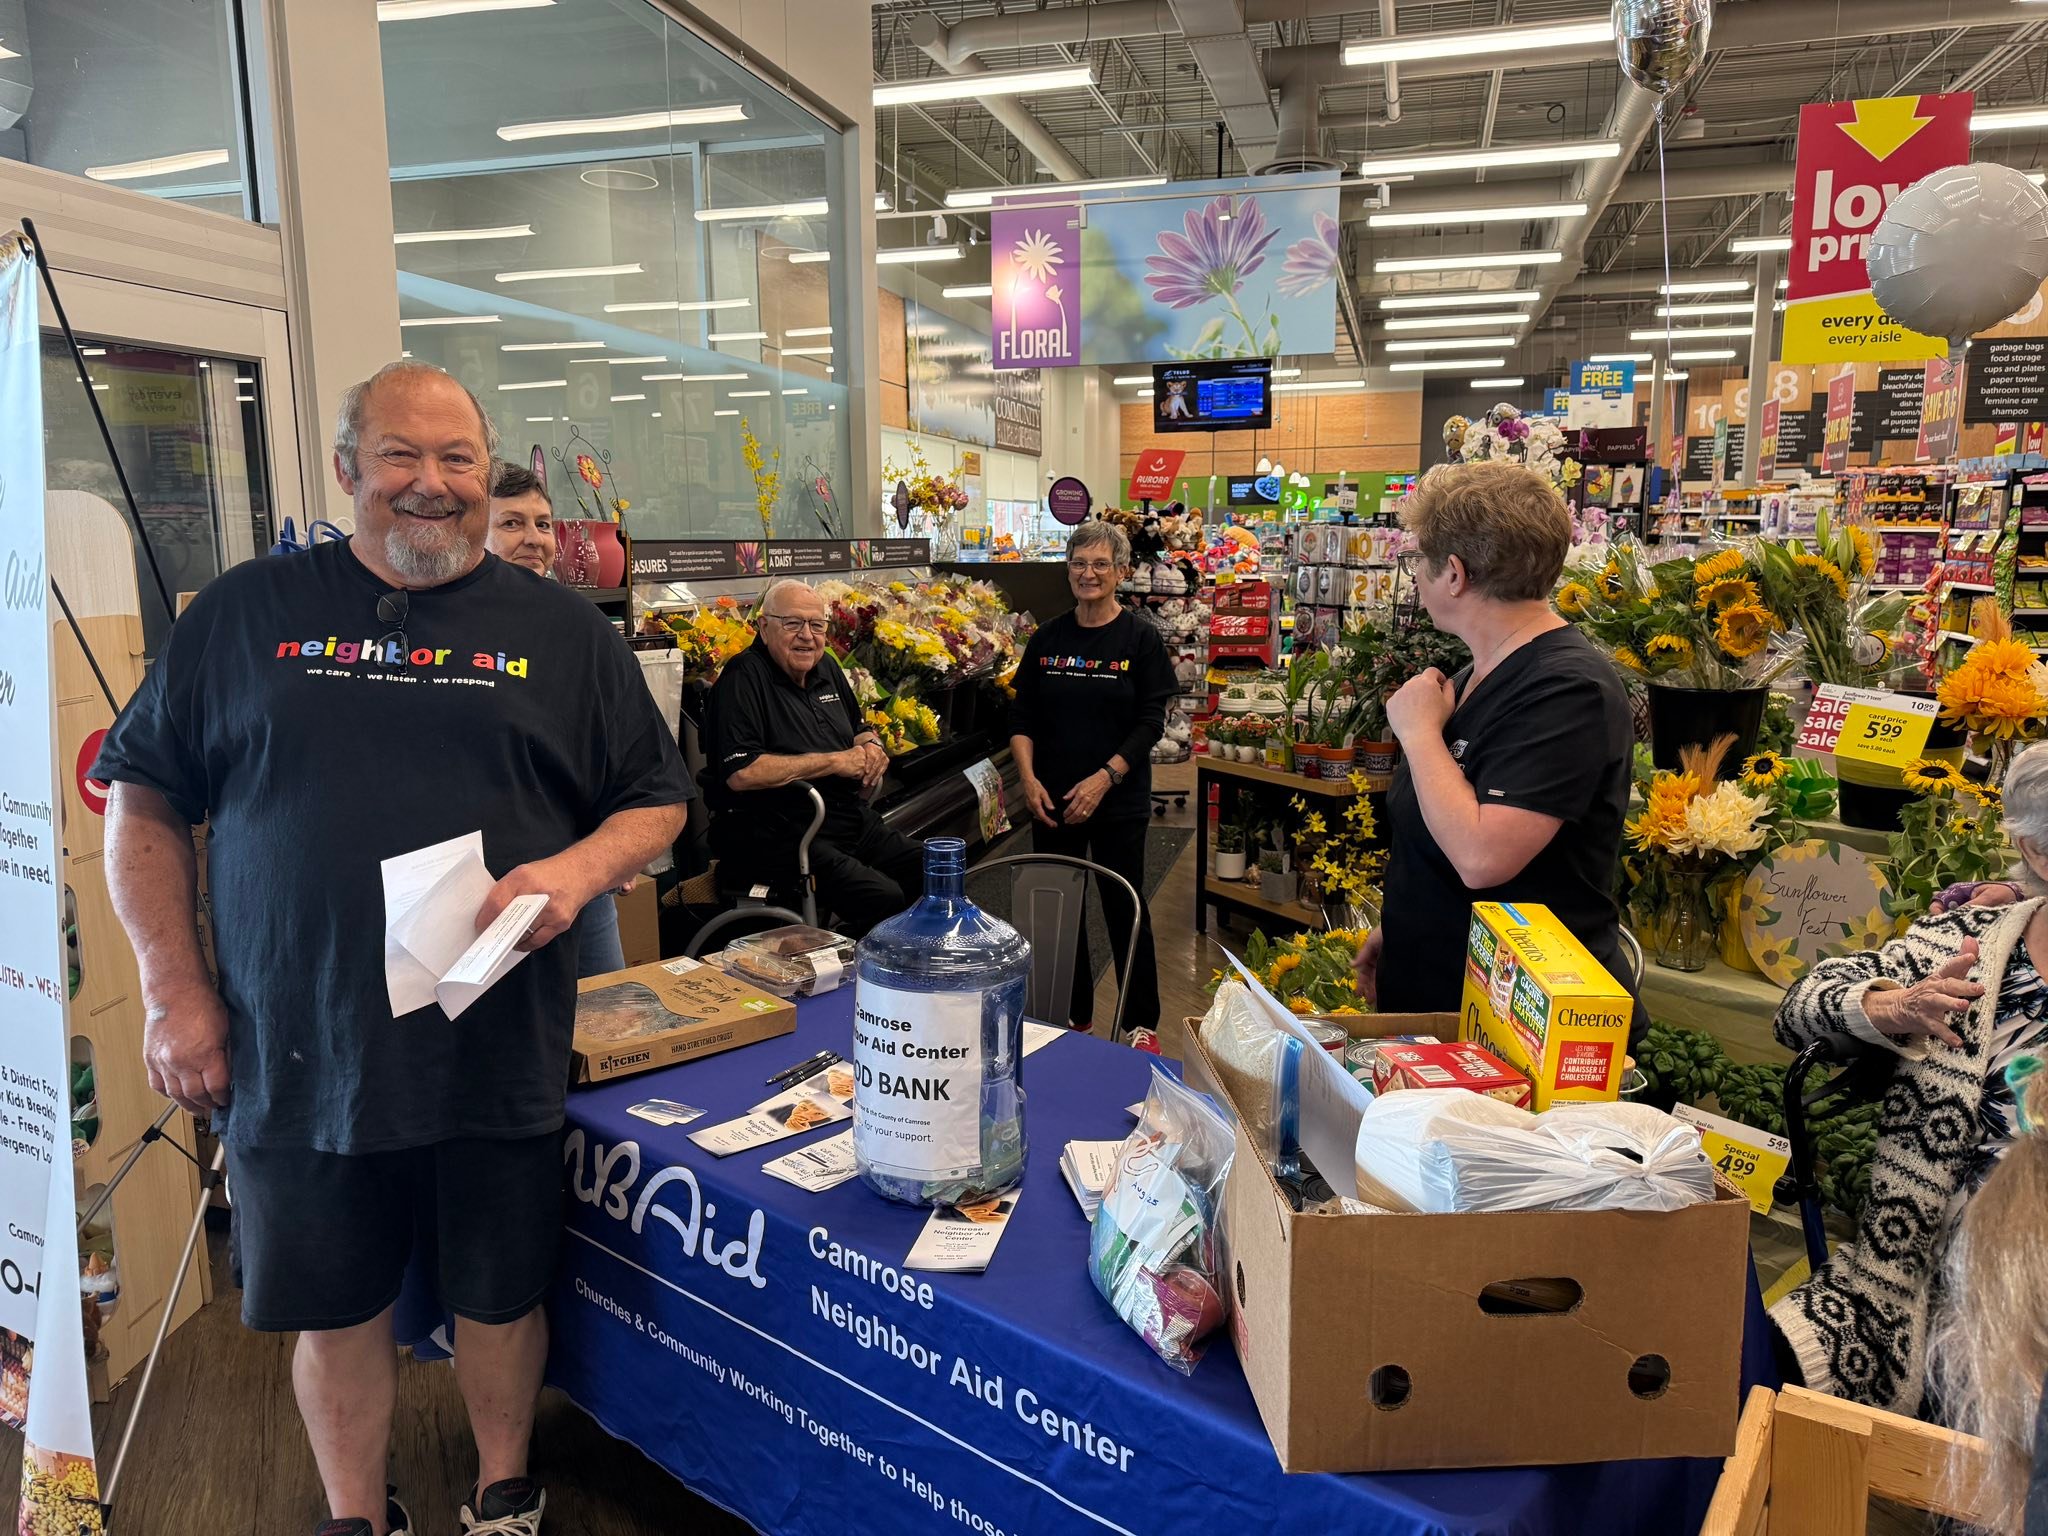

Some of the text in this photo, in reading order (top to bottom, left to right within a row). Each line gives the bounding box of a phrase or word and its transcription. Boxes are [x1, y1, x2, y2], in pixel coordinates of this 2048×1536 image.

[1809, 229, 1868, 272] pri
[1822, 313, 1905, 331] every da
[1000, 328, 1072, 360] FLORAL
[1828, 331, 1902, 346] every aisle
[1990, 343, 2045, 353] garbage bags
[1582, 363, 1609, 372] always
[1990, 354, 2041, 364] food storage
[1581, 370, 1623, 387] FREE
[1888, 374, 1913, 382] laundry
[1984, 364, 2045, 375] cups and plates
[1772, 370, 1799, 404] 8
[1990, 375, 2037, 385] paper towel
[1980, 387, 2020, 395] bathroom
[1554, 398, 1569, 410] FR
[1924, 392, 1942, 423] SAVE
[1985, 397, 2019, 405] feminine
[1694, 404, 1721, 430] 10
[1992, 408, 2028, 416] shampoo
[1890, 419, 1917, 427] purpose
[2028, 436, 2041, 450] low
[1137, 475, 1169, 484] AURORA
[1284, 492, 1293, 502] 5
[769, 557, 773, 567] A
[775, 556, 793, 567] DAISY
[5, 549, 43, 611] Aid
[276, 636, 528, 679] neighbor aid
[1040, 655, 1102, 669] neighbor
[326, 669, 351, 677] care
[386, 674, 417, 683] listen
[452, 678, 495, 688] respond
[1810, 699, 1850, 716] sale
[1804, 715, 1844, 731] sale
[1868, 713, 1907, 725] card price
[1797, 731, 1838, 748] sale
[3, 792, 52, 827] Community
[11, 858, 20, 877] in
[22, 865, 53, 886] need.
[1767, 872, 1848, 917] Sunflower
[1799, 908, 1838, 936] Fest
[1506, 928, 1548, 963] Cheerios
[35, 975, 52, 998] WE
[1558, 1009, 1624, 1027] Cheerios
[671, 1032, 734, 1054] HAND STRETCHED CRUST
[871, 1037, 969, 1059] Aid Center
[600, 1052, 650, 1072] KITCHEN
[1456, 1051, 1503, 1077] PREMIUM
[1458, 1063, 1488, 1078] PLUS
[1564, 1057, 1607, 1066] CONTRIBUENT
[10, 1068, 41, 1093] District
[854, 1059, 950, 1101] OD BANK
[6, 1091, 25, 1109] Kids
[18, 1117, 41, 1137] Free
[878, 1112, 897, 1122] County
[905, 1117, 931, 1126] Camrose
[875, 1126, 893, 1137] your
[895, 1130, 934, 1143] support.
[1723, 1143, 1760, 1162] Special
[1716, 1154, 1756, 1176] 499
[1731, 1173, 1745, 1181] each
[8, 1223, 45, 1248] Camro
[809, 1227, 934, 1310] Camrose
[812, 1285, 1135, 1474] Neighbor Aid Center
[575, 1277, 631, 1325] Churches
[635, 1313, 645, 1333] &
[648, 1321, 726, 1383] Community
[729, 1367, 793, 1424] Working
[797, 1407, 874, 1466] Together
[879, 1456, 897, 1480] to
[903, 1468, 944, 1511] Help
